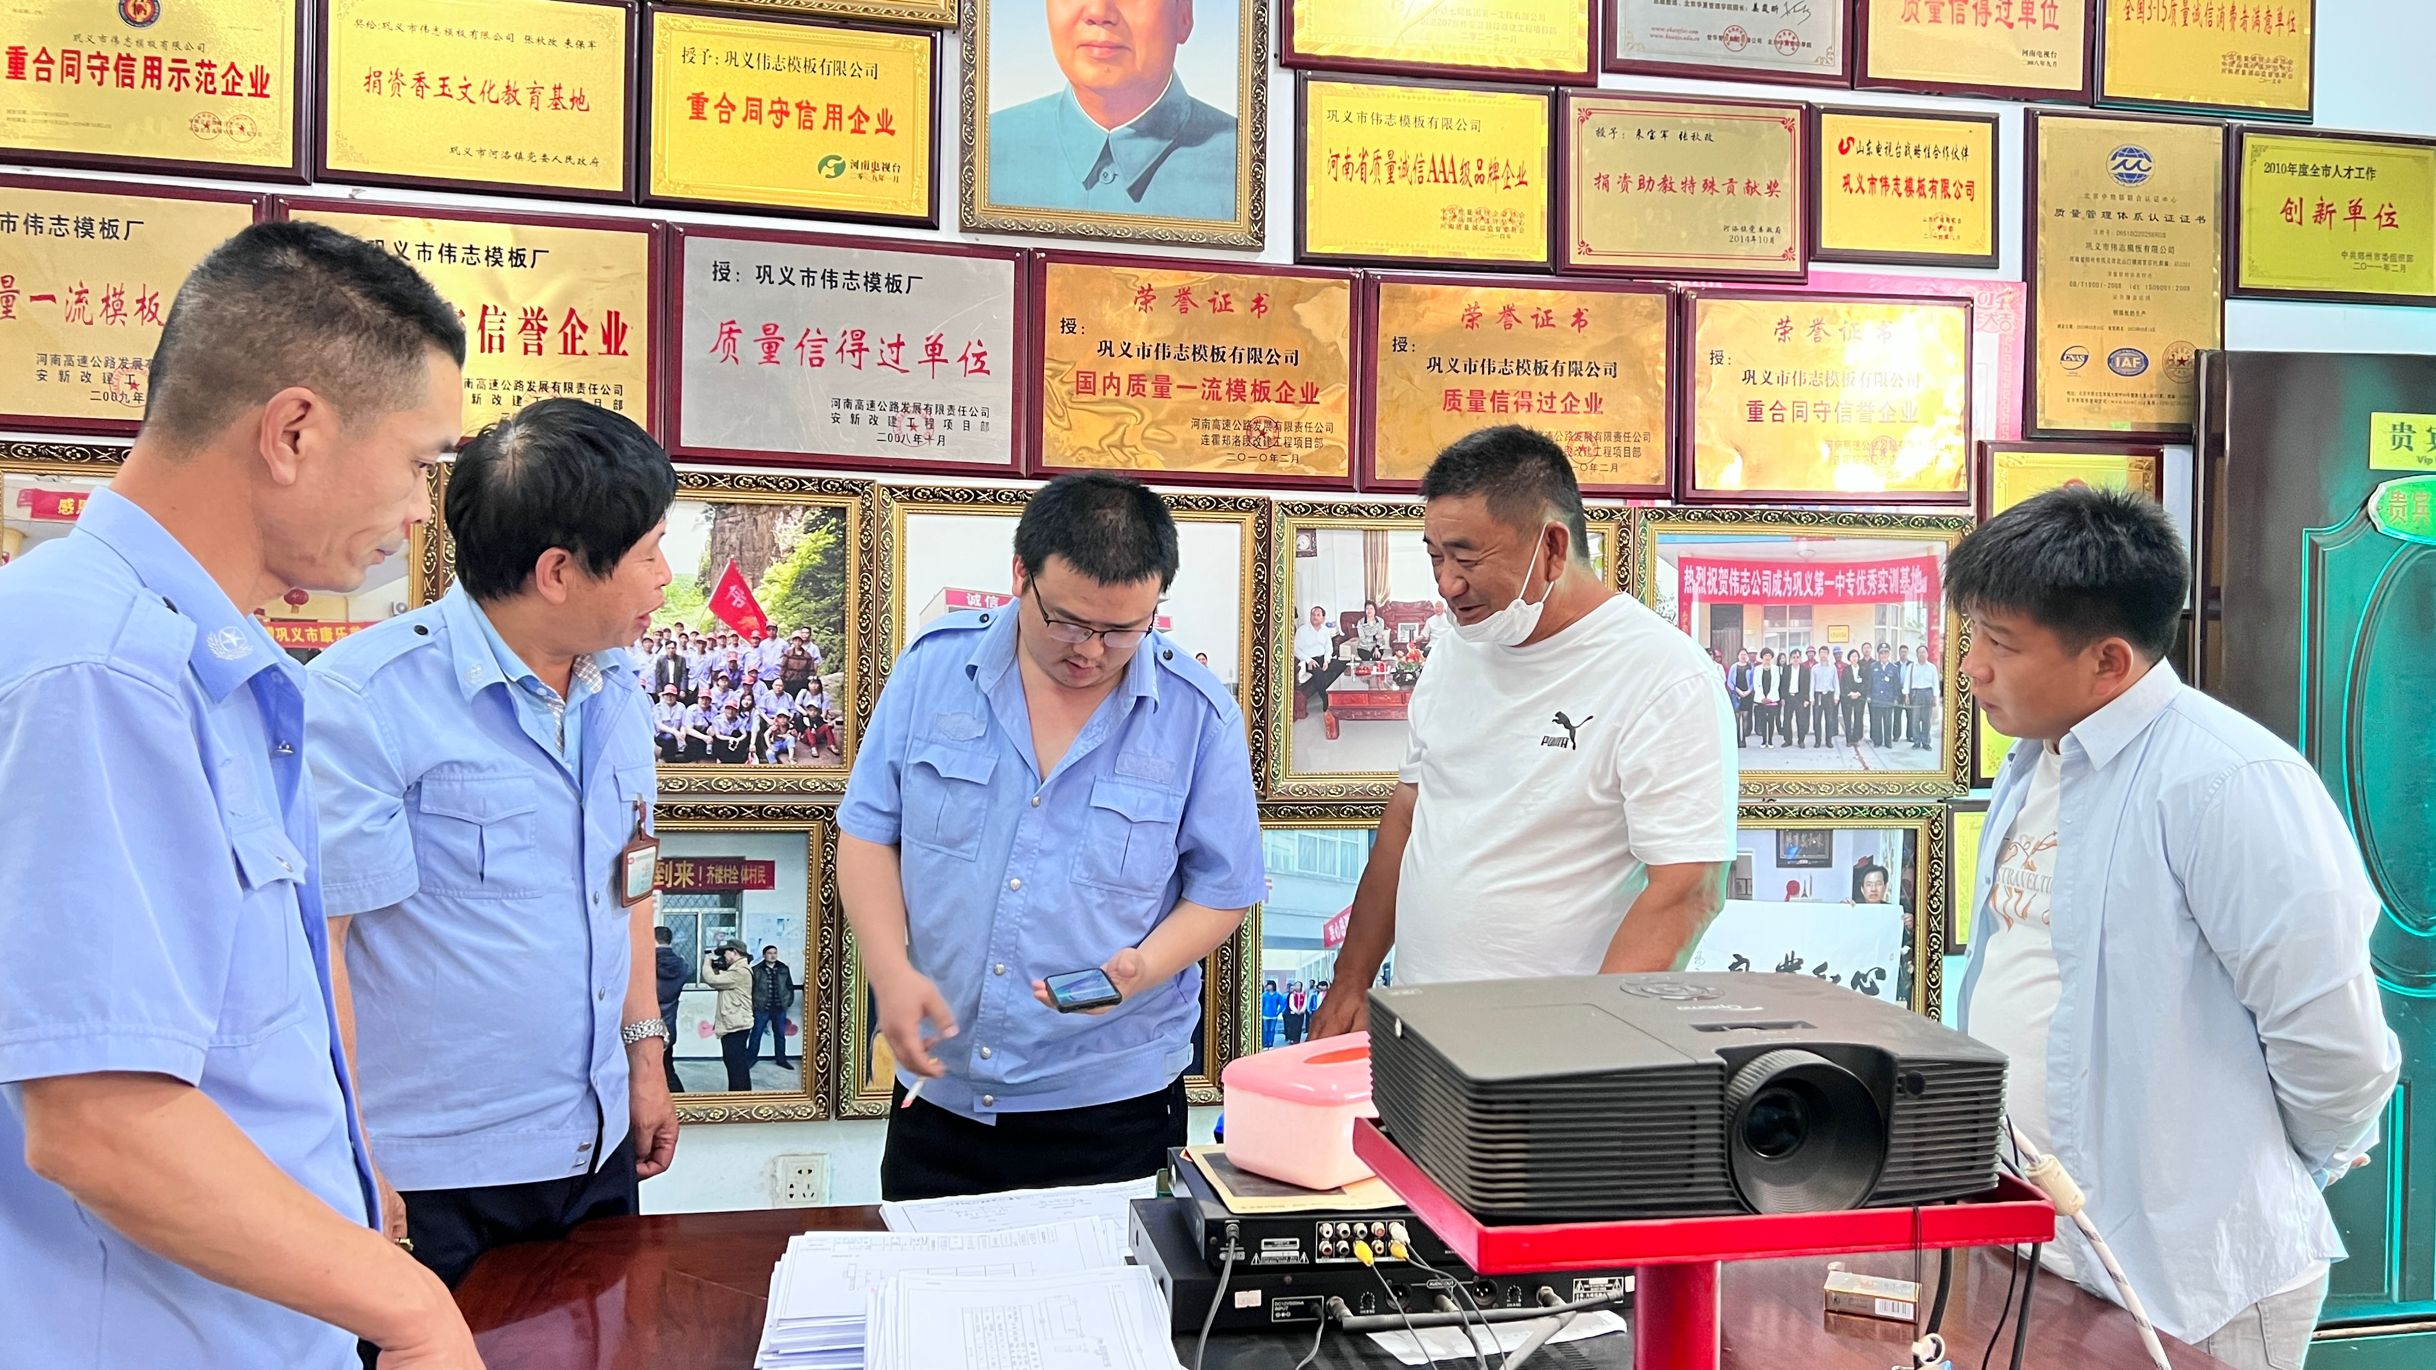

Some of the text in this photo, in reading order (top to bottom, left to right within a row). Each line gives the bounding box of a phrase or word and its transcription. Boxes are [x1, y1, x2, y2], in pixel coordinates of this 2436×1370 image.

[1901, 0, 2061, 31] 质量信得过单位
[5, 45, 271, 99] 重合同守信用示范企业
[362, 66, 591, 113] 捐资香玉文化教育基地
[686, 91, 896, 137] 重合同守信用企业
[1327, 109, 1481, 133] 巩义市伟志模板有限公司
[449, 146, 600, 168] 巩义市河洛镇党委人民政府
[849, 158, 901, 174] 河南电视台
[1327, 146, 1529, 194] 河南省质量诚信AAA级品牌企业
[1593, 171, 1782, 199] 捐资助教特殊贡献奖
[2263, 161, 2377, 182] 2010年度全市人才工作
[1842, 172, 1976, 202] 巩义市伟志模板有限公司
[0, 211, 145, 241] 市伟志模板厂
[2053, 208, 2208, 225] 质量管理体系认证证书
[2279, 195, 2400, 232] 创新单位
[1728, 233, 1776, 245] 2014年10月
[755, 264, 924, 295] 巩义市伟志模板厂
[0, 273, 166, 327] 量一流模板
[1133, 282, 1271, 321] 荣誉证书
[1460, 300, 1591, 333] 荣誉证书
[1773, 315, 1896, 344] 荣誉证书
[709, 318, 992, 380] 质量信得过单位
[1096, 339, 1300, 367] 巩义市伟志模板有限公司
[2115, 356, 2142, 369] IAF
[1426, 356, 1619, 379] 巩义市伟志模板有限公司
[1741, 368, 1921, 390] 巩义市伟志模板有限公司
[1074, 370, 1321, 406] 国内质量一流模板企业
[1441, 388, 1605, 416] 质量信得过企业
[831, 396, 992, 419] 河南高速公路发展有限责任公司
[1746, 399, 1919, 425] 重合同守信誉企业
[831, 411, 991, 433] 安新改建工程项目部
[1190, 416, 1335, 434] 河南高速公路发展有限责任公司
[1200, 433, 1324, 449] 连霍郑洛段改建工程项目部
[1684, 563, 1928, 599] 热烈祝贺伟志公司成为巩义第一中专优秀实训基地
[1541, 735, 1570, 749] PUMA
